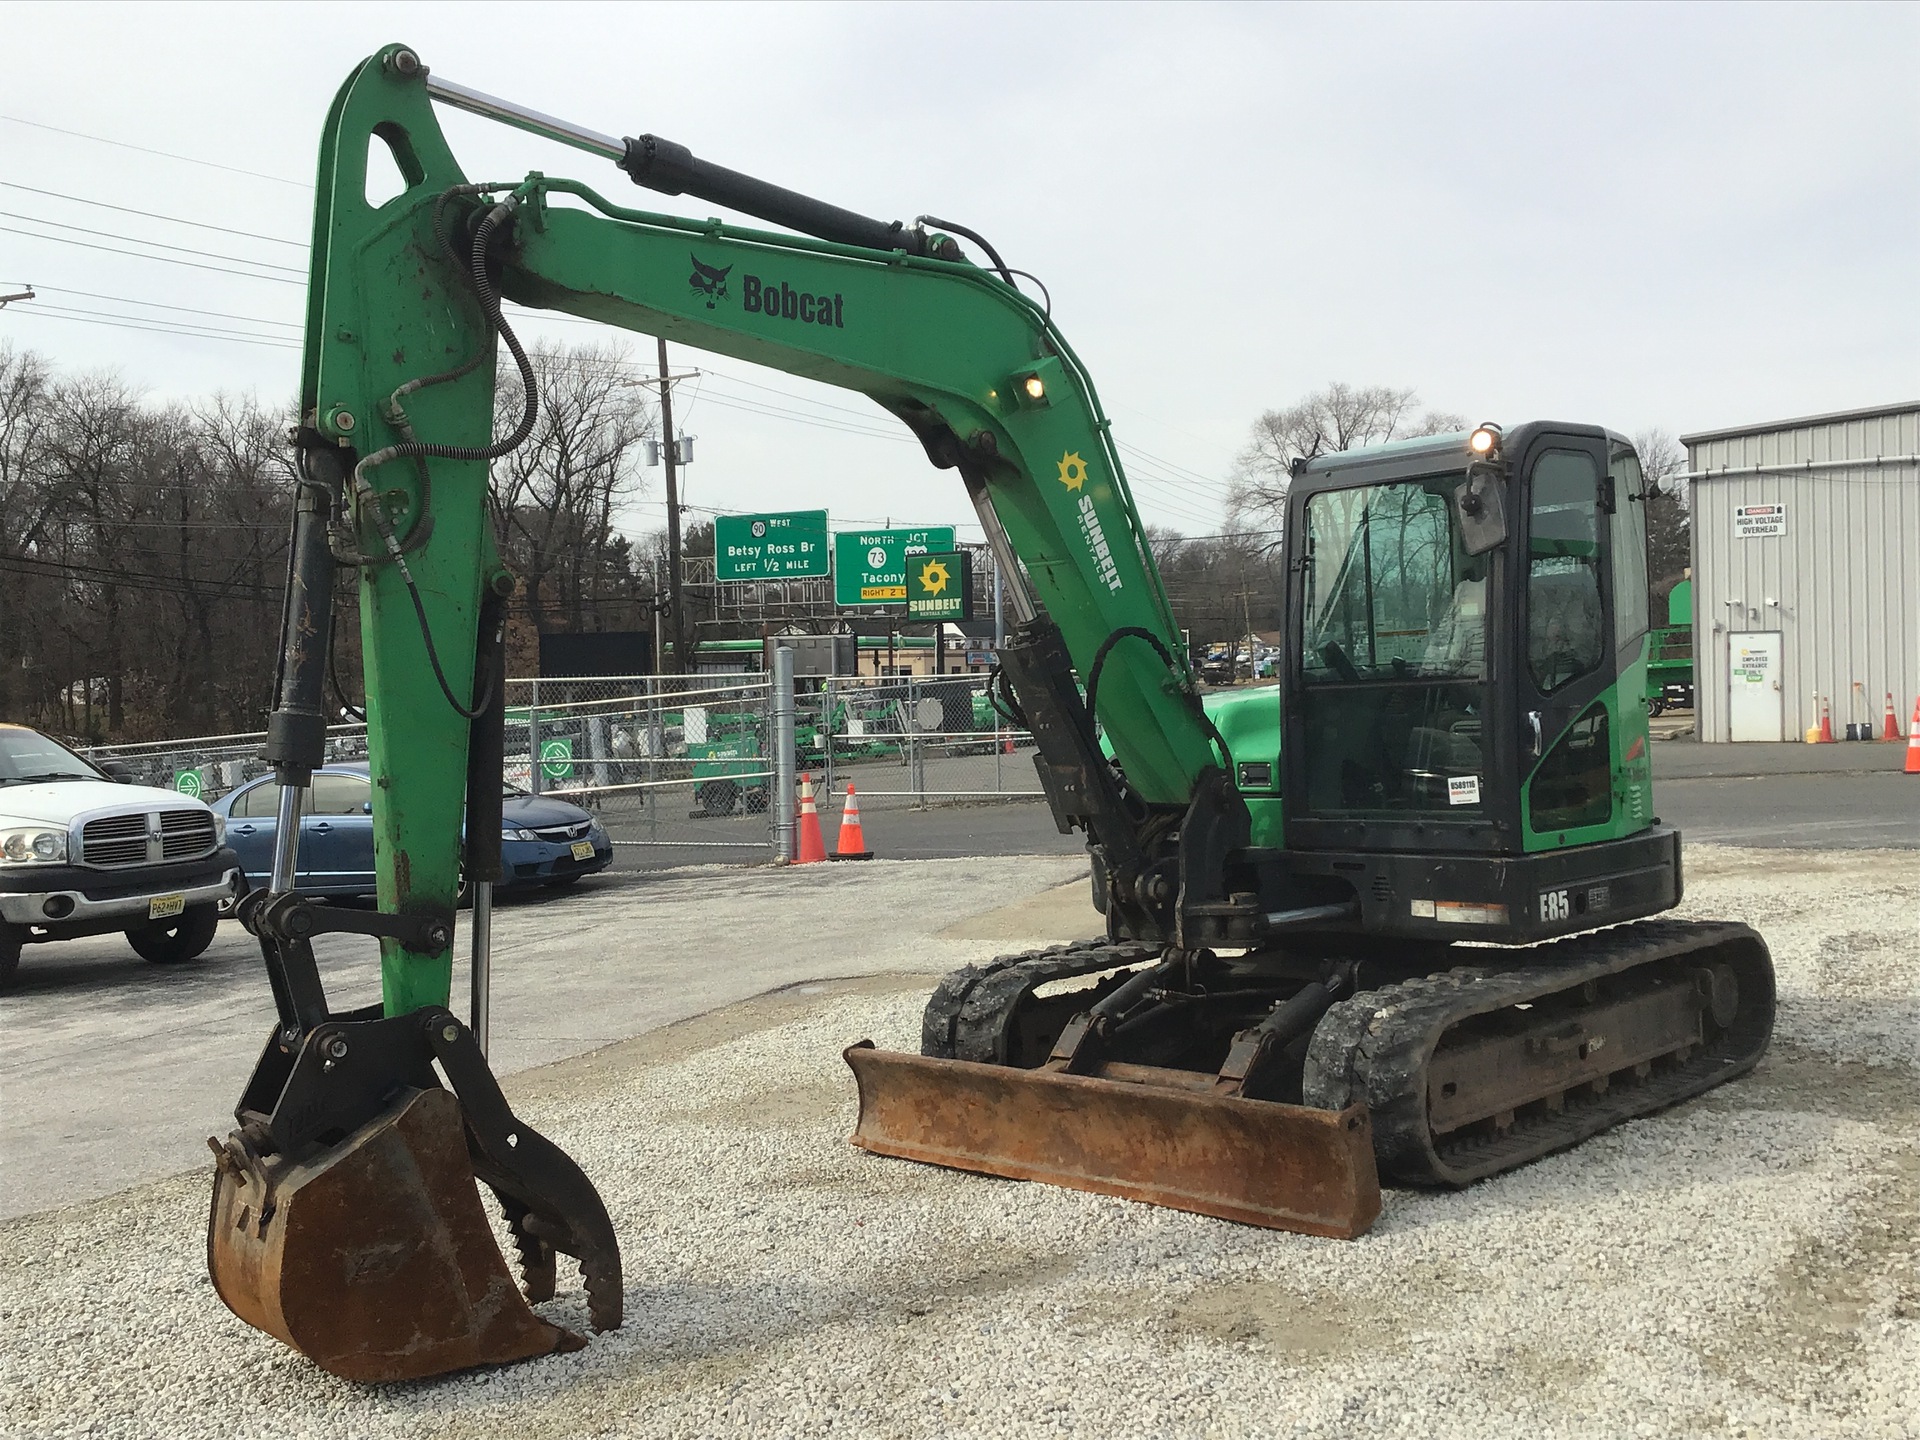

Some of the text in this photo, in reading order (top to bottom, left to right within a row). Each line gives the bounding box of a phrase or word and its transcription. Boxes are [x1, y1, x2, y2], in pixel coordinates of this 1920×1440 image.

[743, 274, 844, 329] Bobcat
[1755, 516, 1783, 525] VOLTAGE
[753, 522, 764, 534] 90
[1743, 525, 1778, 534] OVERHEAD
[860, 533, 928, 545] NORTH JCT
[1078, 494, 1123, 591] SUNBELT
[728, 542, 815, 559] Betsy Ross Br
[1076, 514, 1106, 584] RENTALS
[870, 552, 885, 563] 73
[735, 558, 809, 572] LEFT 1/2 MILE
[861, 573, 906, 584] Tacony
[862, 589, 884, 597] RIGHT
[890, 588, 896, 596] 2
[909, 598, 962, 612] SUNBELT
[1539, 890, 1570, 923] E85
